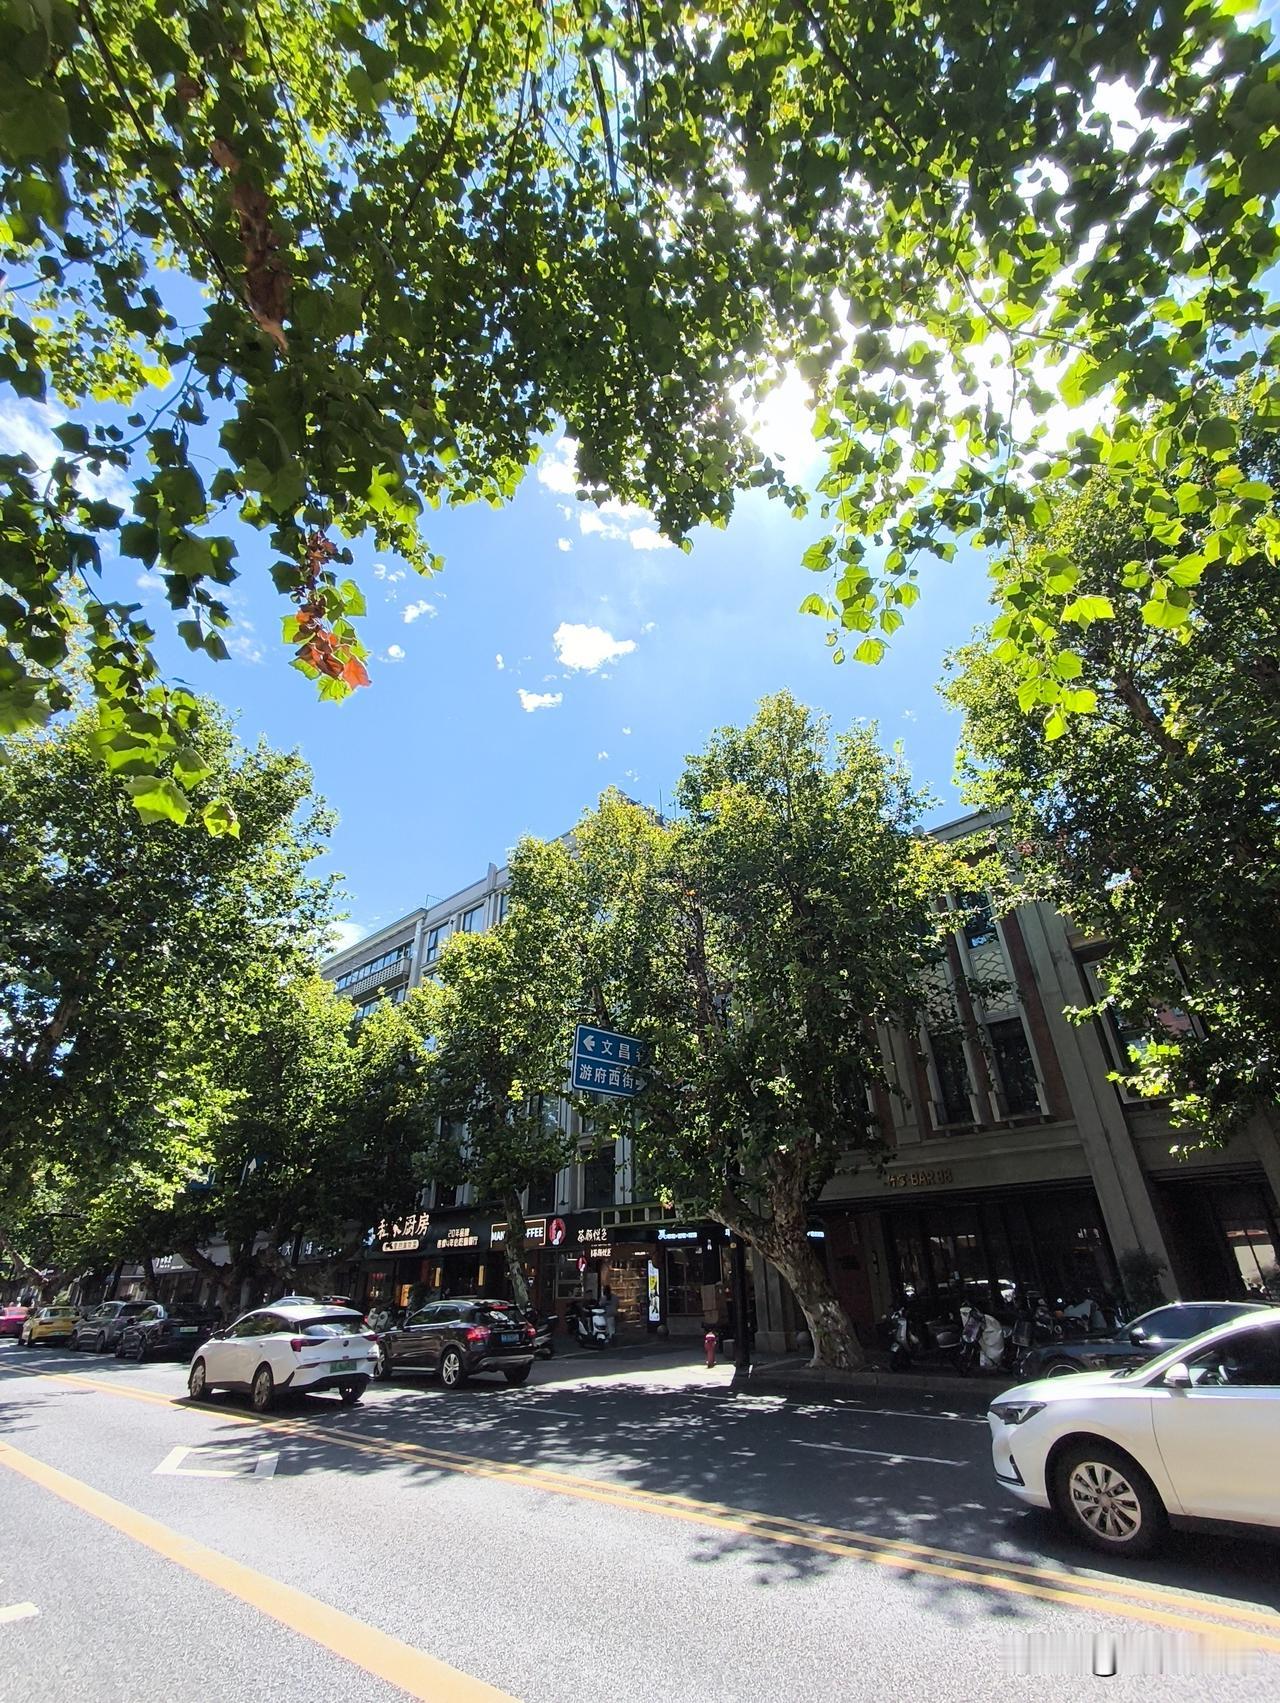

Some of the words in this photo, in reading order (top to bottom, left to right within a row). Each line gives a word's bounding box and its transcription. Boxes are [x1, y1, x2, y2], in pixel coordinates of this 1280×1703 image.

[579, 1063, 634, 1089] 游府西街
[525, 1227, 544, 1238] FFEE
